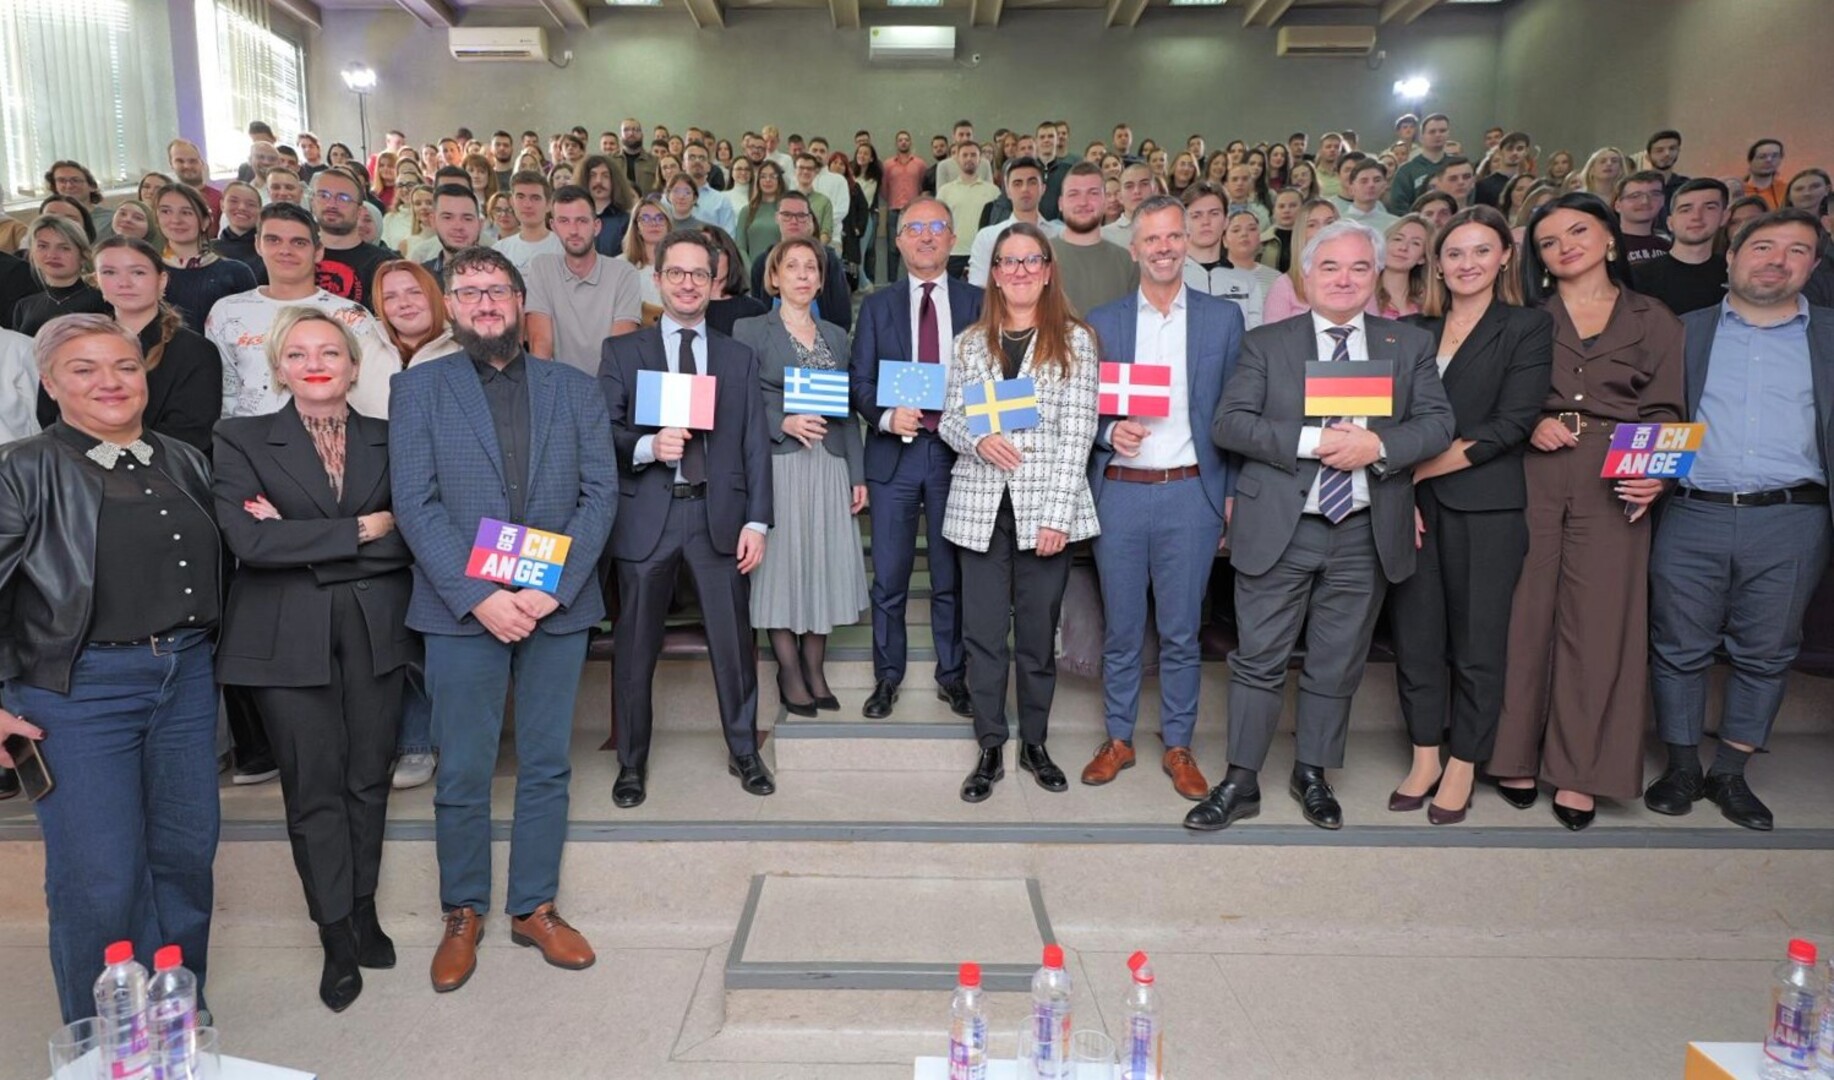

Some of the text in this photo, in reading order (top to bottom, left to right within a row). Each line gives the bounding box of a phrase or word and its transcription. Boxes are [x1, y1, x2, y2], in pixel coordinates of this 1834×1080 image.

[1631, 426, 1652, 449] GEN
[1655, 427, 1691, 449] CH
[1615, 452, 1682, 474] ANGE
[496, 525, 518, 552] GEN
[521, 533, 556, 560] CH
[480, 553, 548, 586] ANGE
